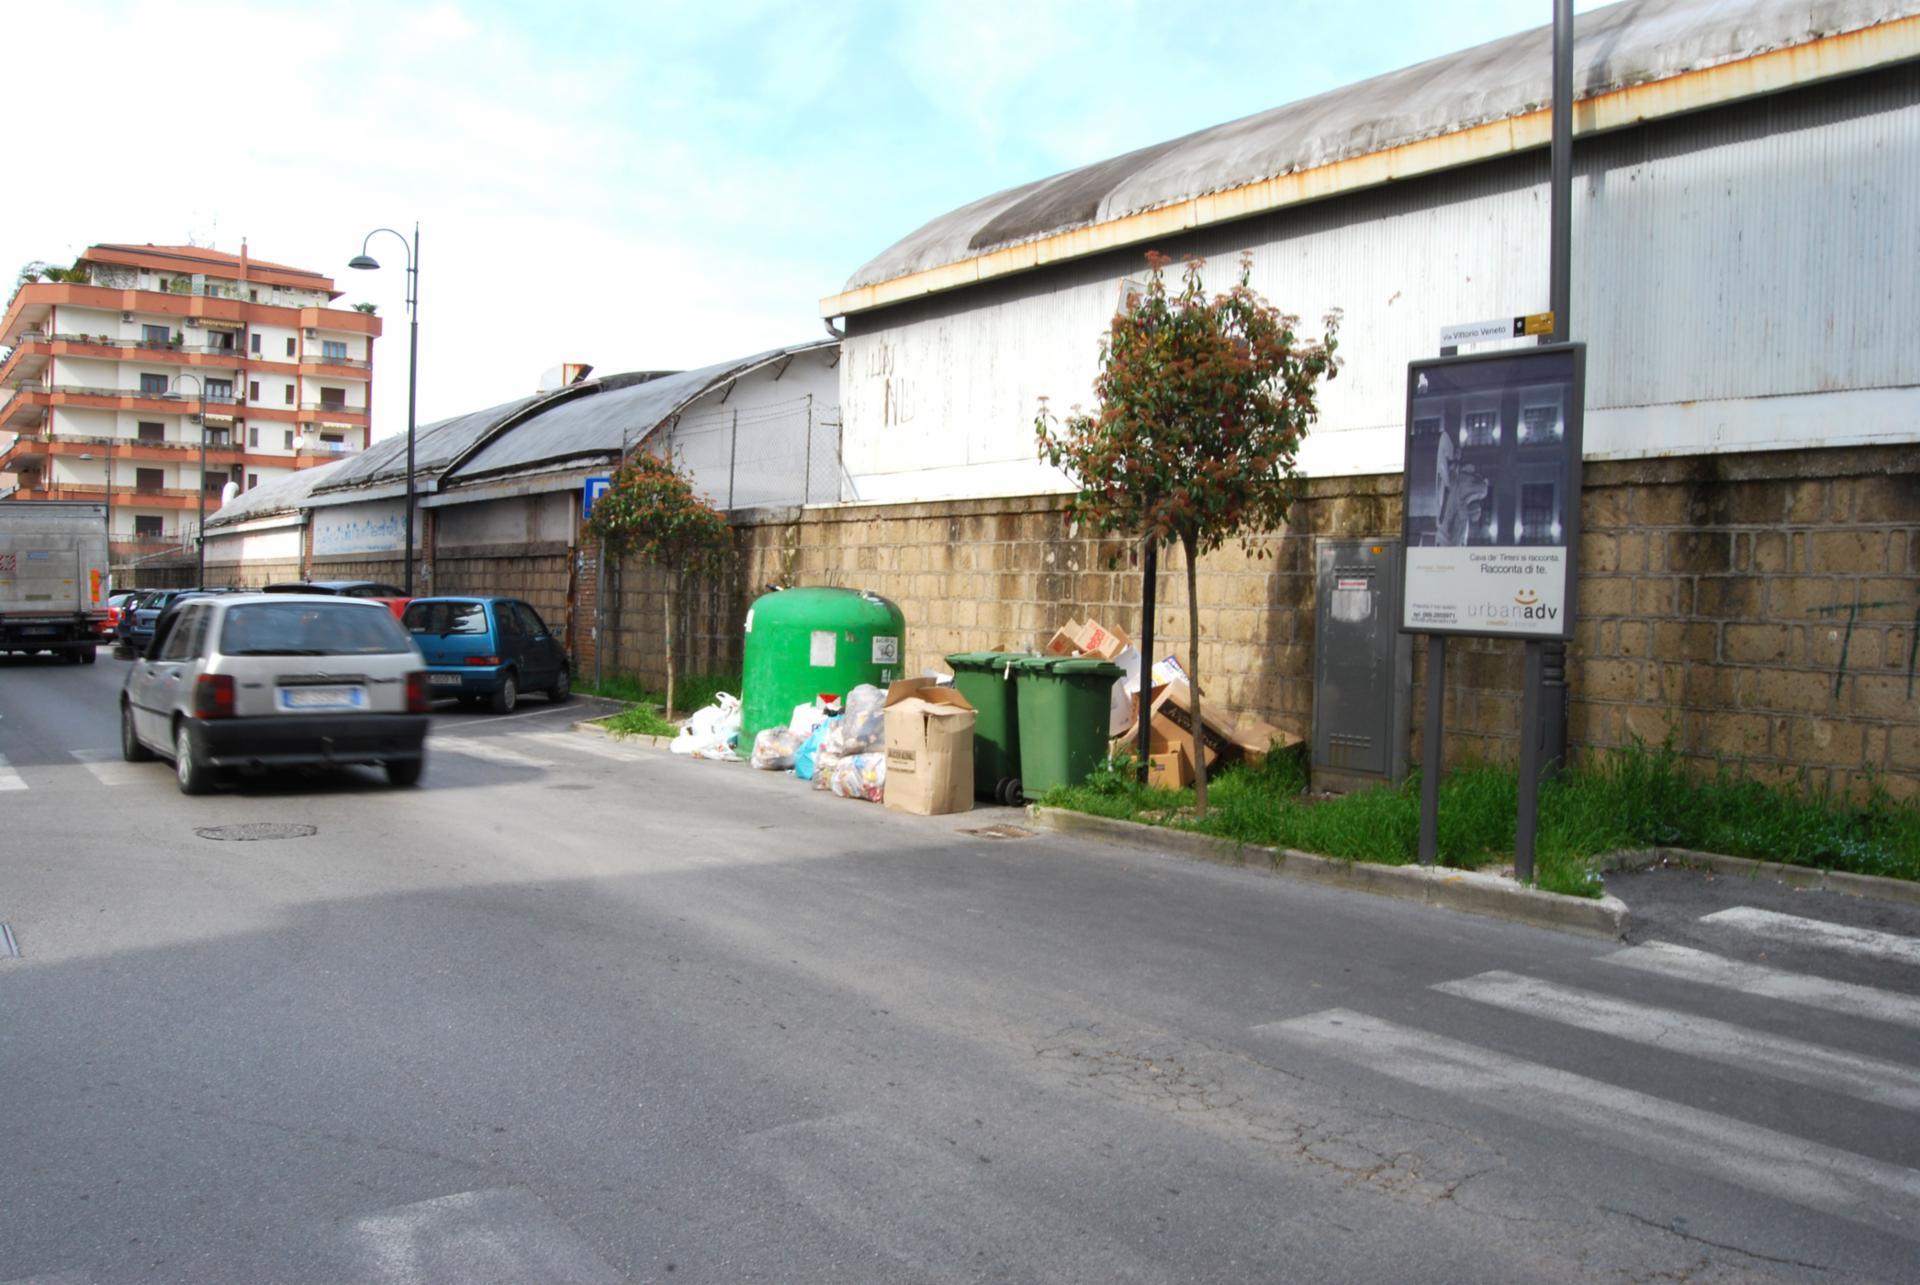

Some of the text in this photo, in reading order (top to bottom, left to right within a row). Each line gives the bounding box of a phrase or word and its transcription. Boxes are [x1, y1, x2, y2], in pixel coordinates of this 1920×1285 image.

[1453, 329, 1479, 339] Vittorio
[1480, 325, 1506, 336] Veneto
[1480, 563, 1548, 574] Racconta di te.
[1467, 602, 1558, 619] urbanadv
